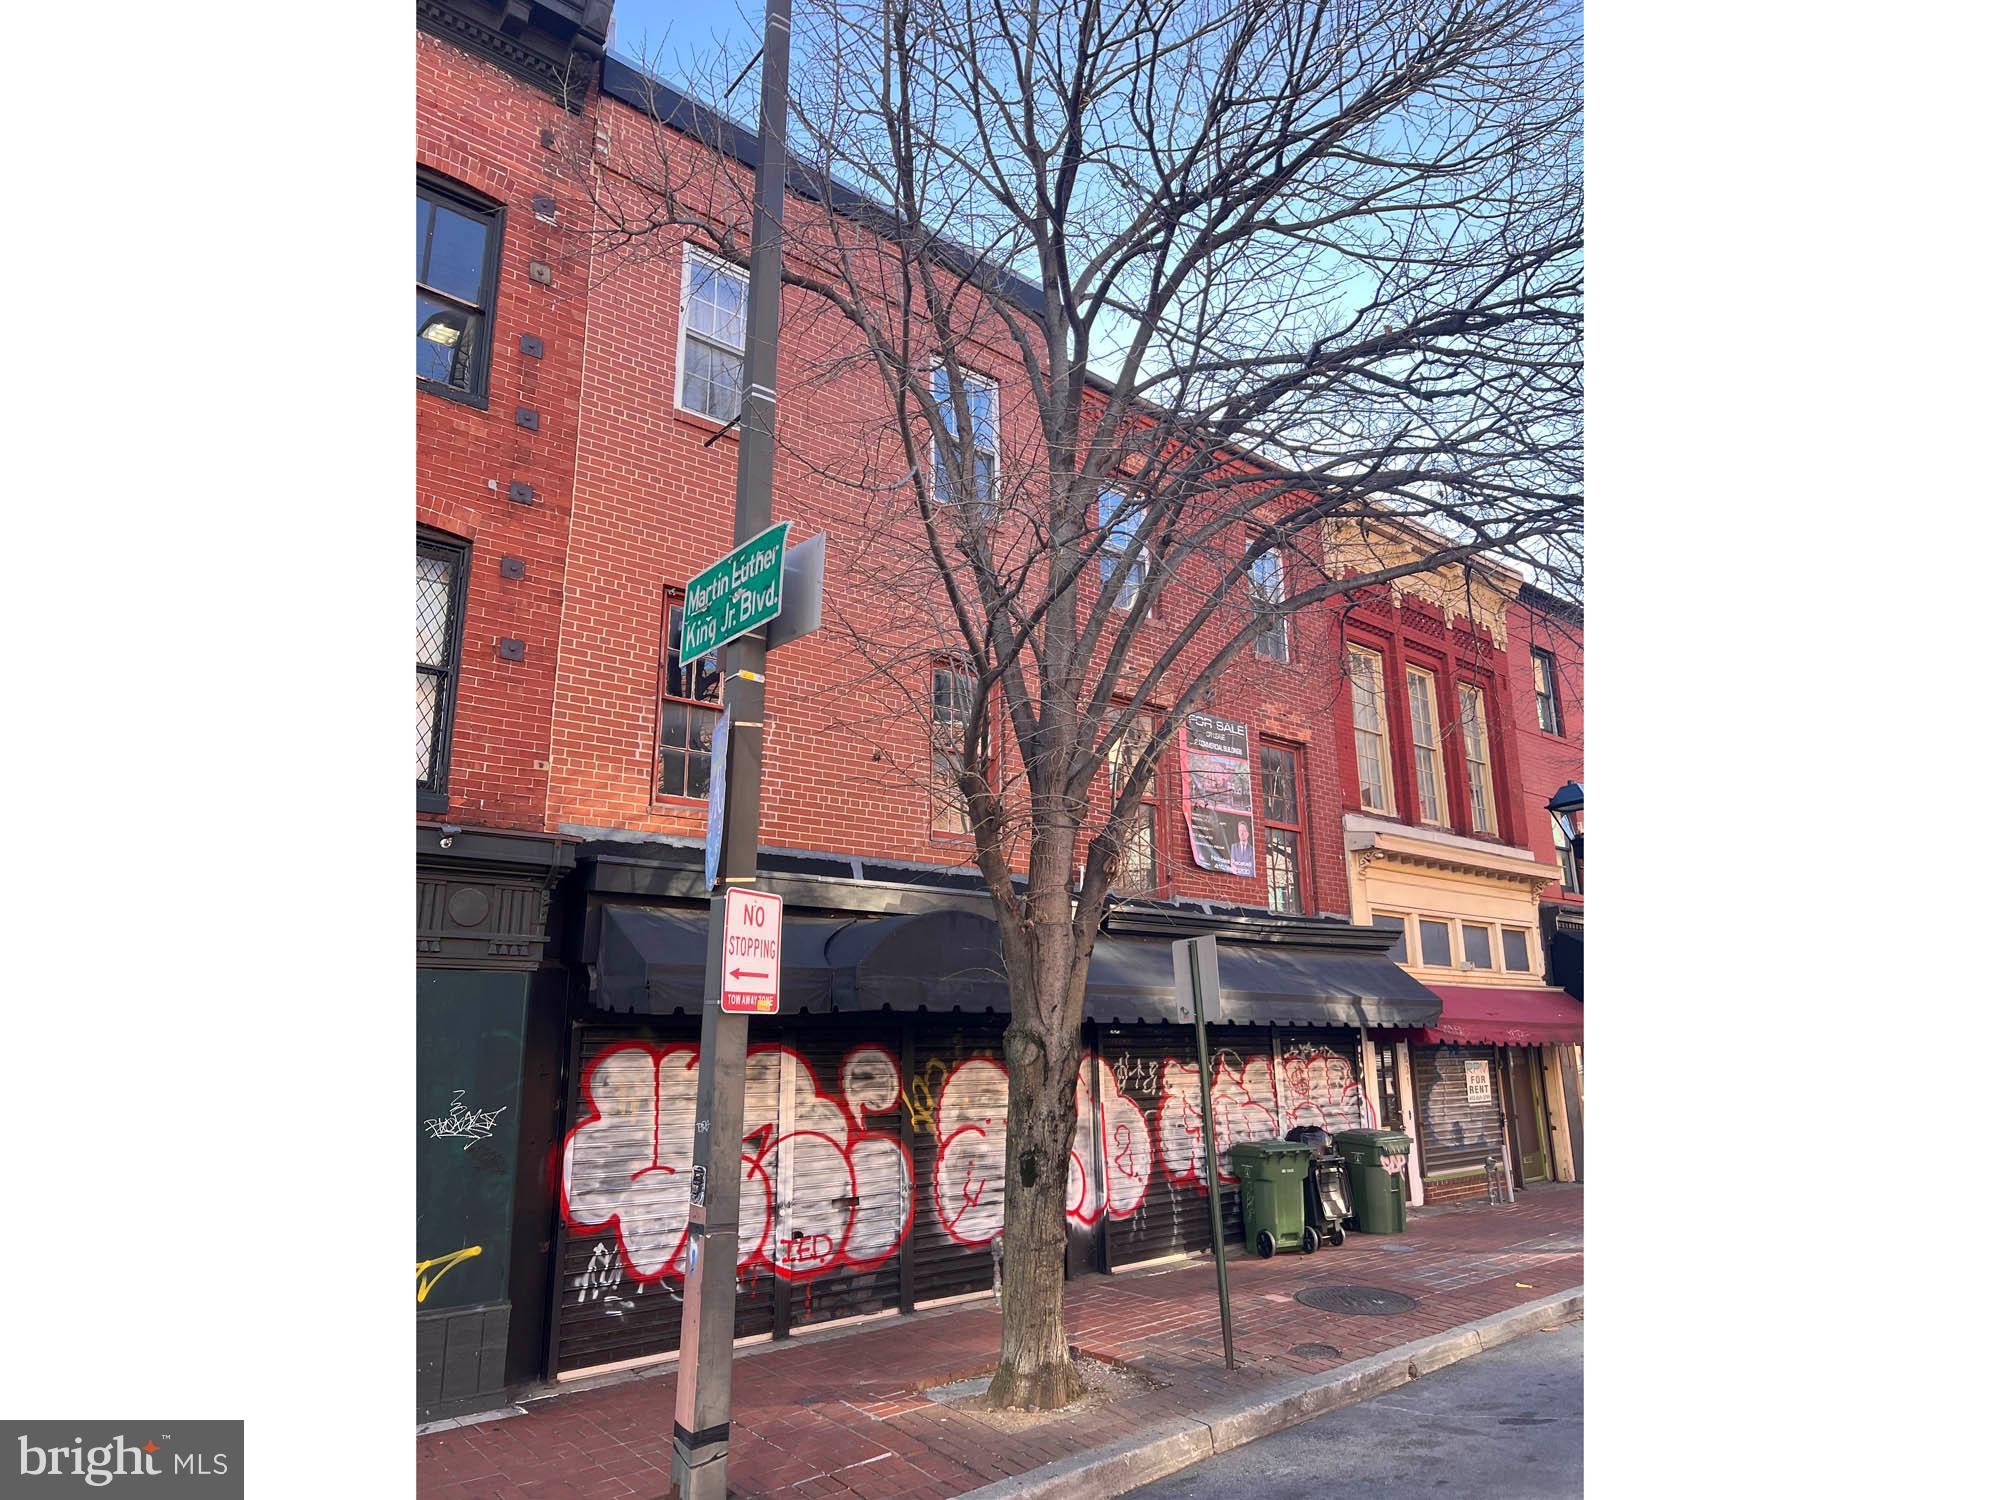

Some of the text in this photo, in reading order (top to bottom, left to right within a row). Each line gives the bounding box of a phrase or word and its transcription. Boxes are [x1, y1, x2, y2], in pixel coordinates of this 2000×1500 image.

[687, 547, 778, 616] Martin Luther
[686, 580, 778, 651] King Jr. Blvd.
[1188, 714, 1245, 736] FOR SALE
[743, 903, 765, 928] NO
[729, 936, 776, 960] STOPPING
[728, 994, 741, 1005] TOW
[741, 994, 757, 1006] AWAY
[1469, 1085, 1488, 1094] RENT
[1470, 1075, 1486, 1084] FOR
